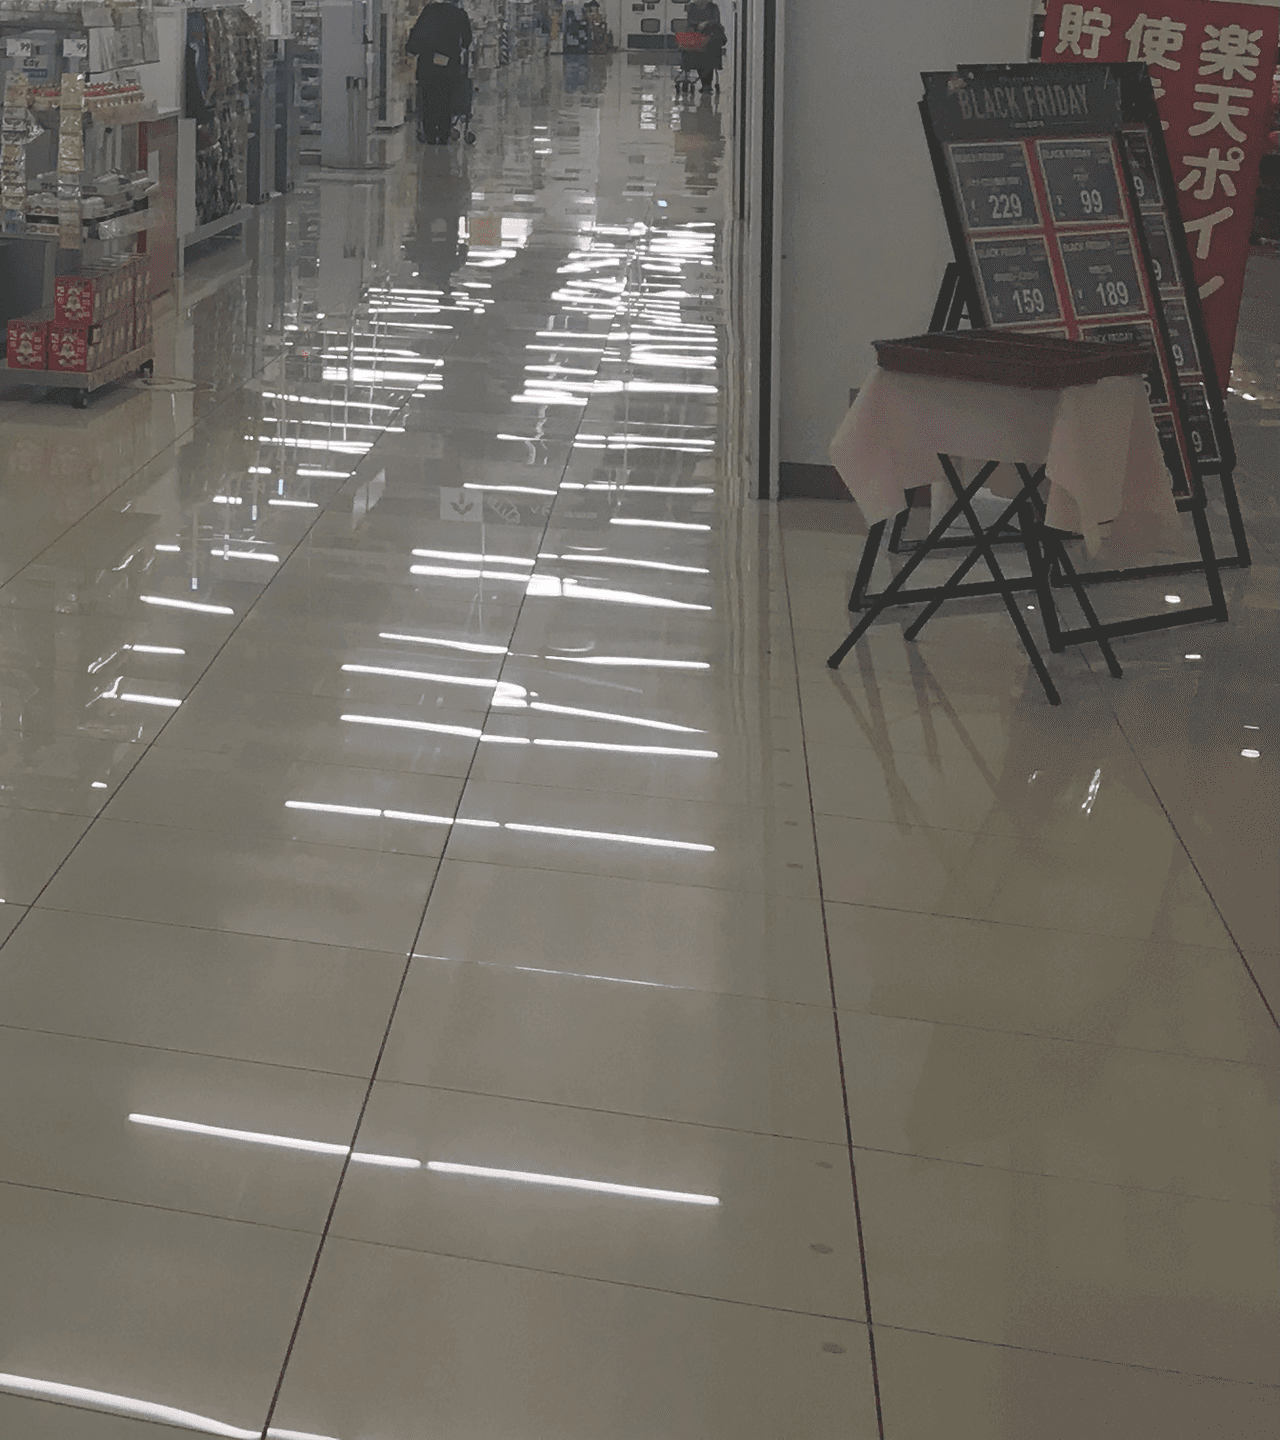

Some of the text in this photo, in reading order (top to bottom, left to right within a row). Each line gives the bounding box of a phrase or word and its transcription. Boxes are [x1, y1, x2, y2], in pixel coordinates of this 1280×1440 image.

[957, 83, 1090, 120] BLACK FRIDAY
[988, 193, 1023, 219] 229
[1080, 189, 1103, 214] 99
[1012, 287, 1045, 314] 159
[1096, 280, 1129, 307] 189
